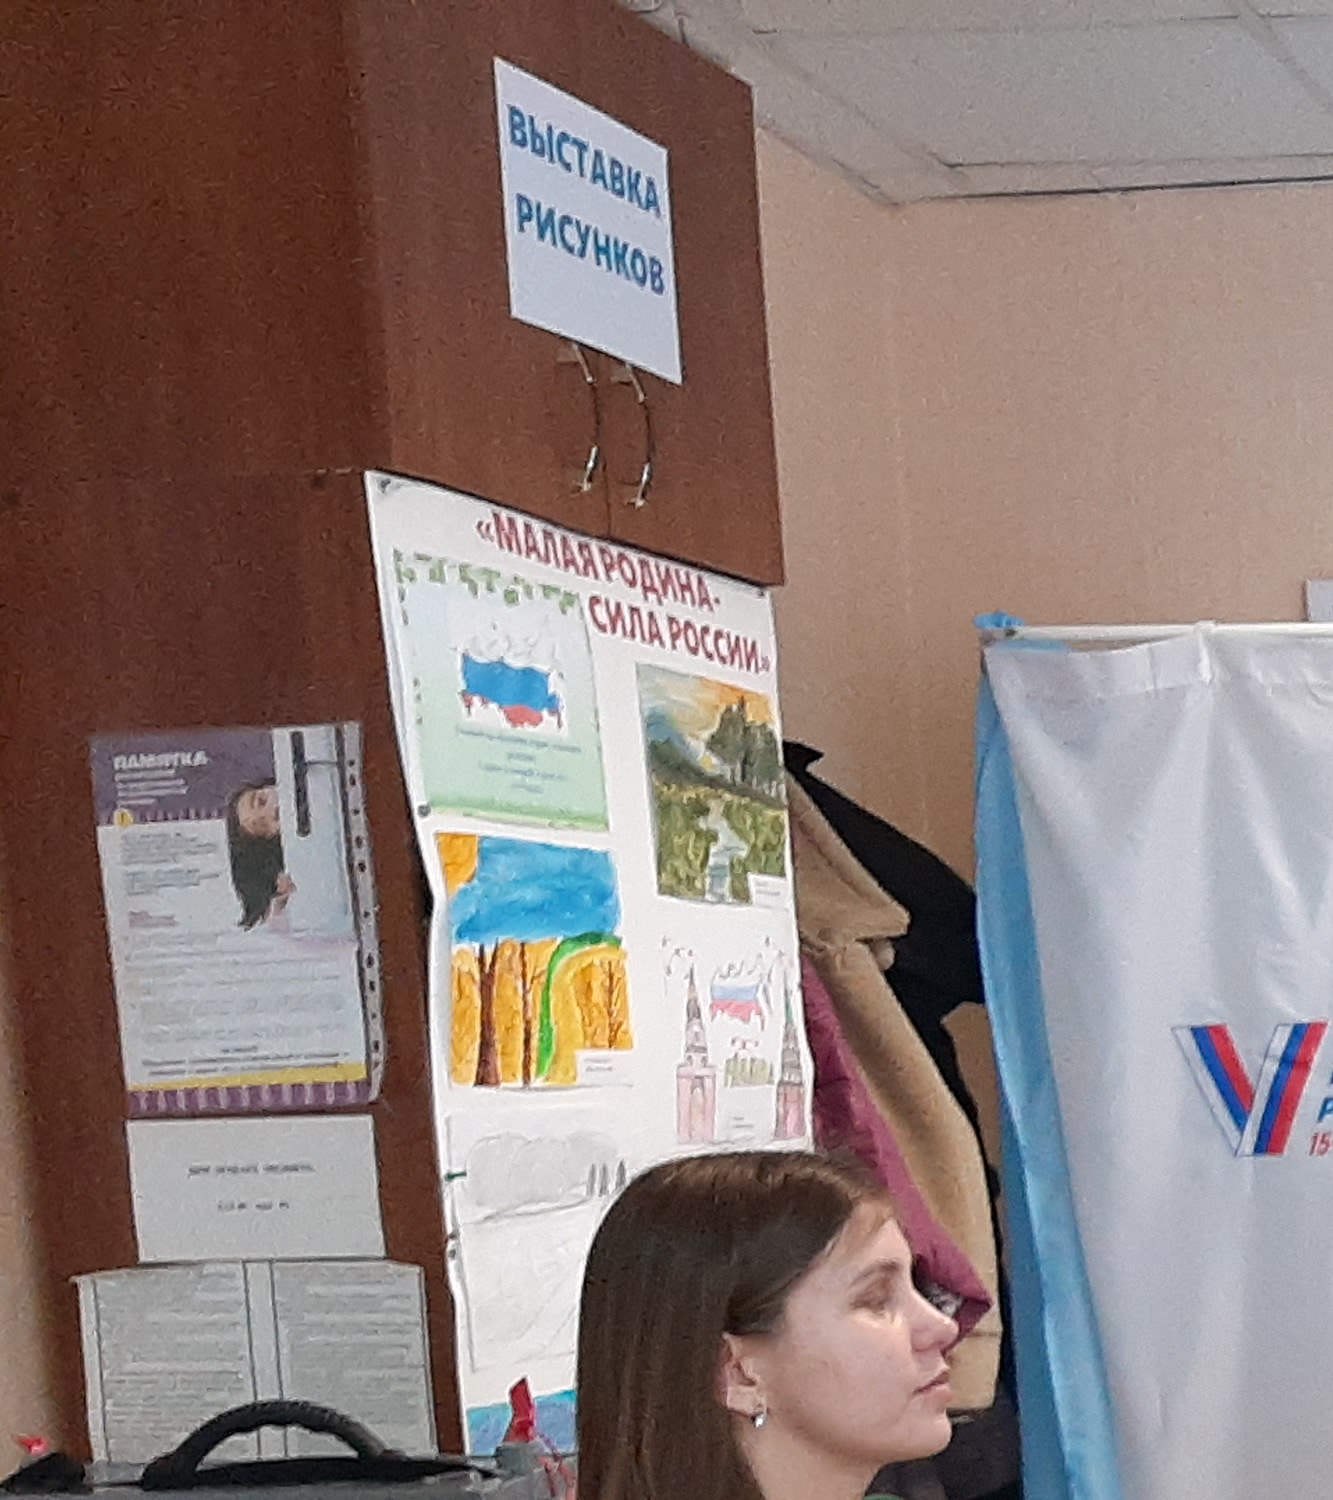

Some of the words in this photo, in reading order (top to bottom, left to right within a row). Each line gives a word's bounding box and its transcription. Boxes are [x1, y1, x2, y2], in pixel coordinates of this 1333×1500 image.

[506, 104, 661, 218] ВЫСТАВКА
[515, 193, 665, 294] РИСУНКОВ
[476, 513, 600, 580] «МАЛАЯ
[587, 596, 667, 650] СИЛА
